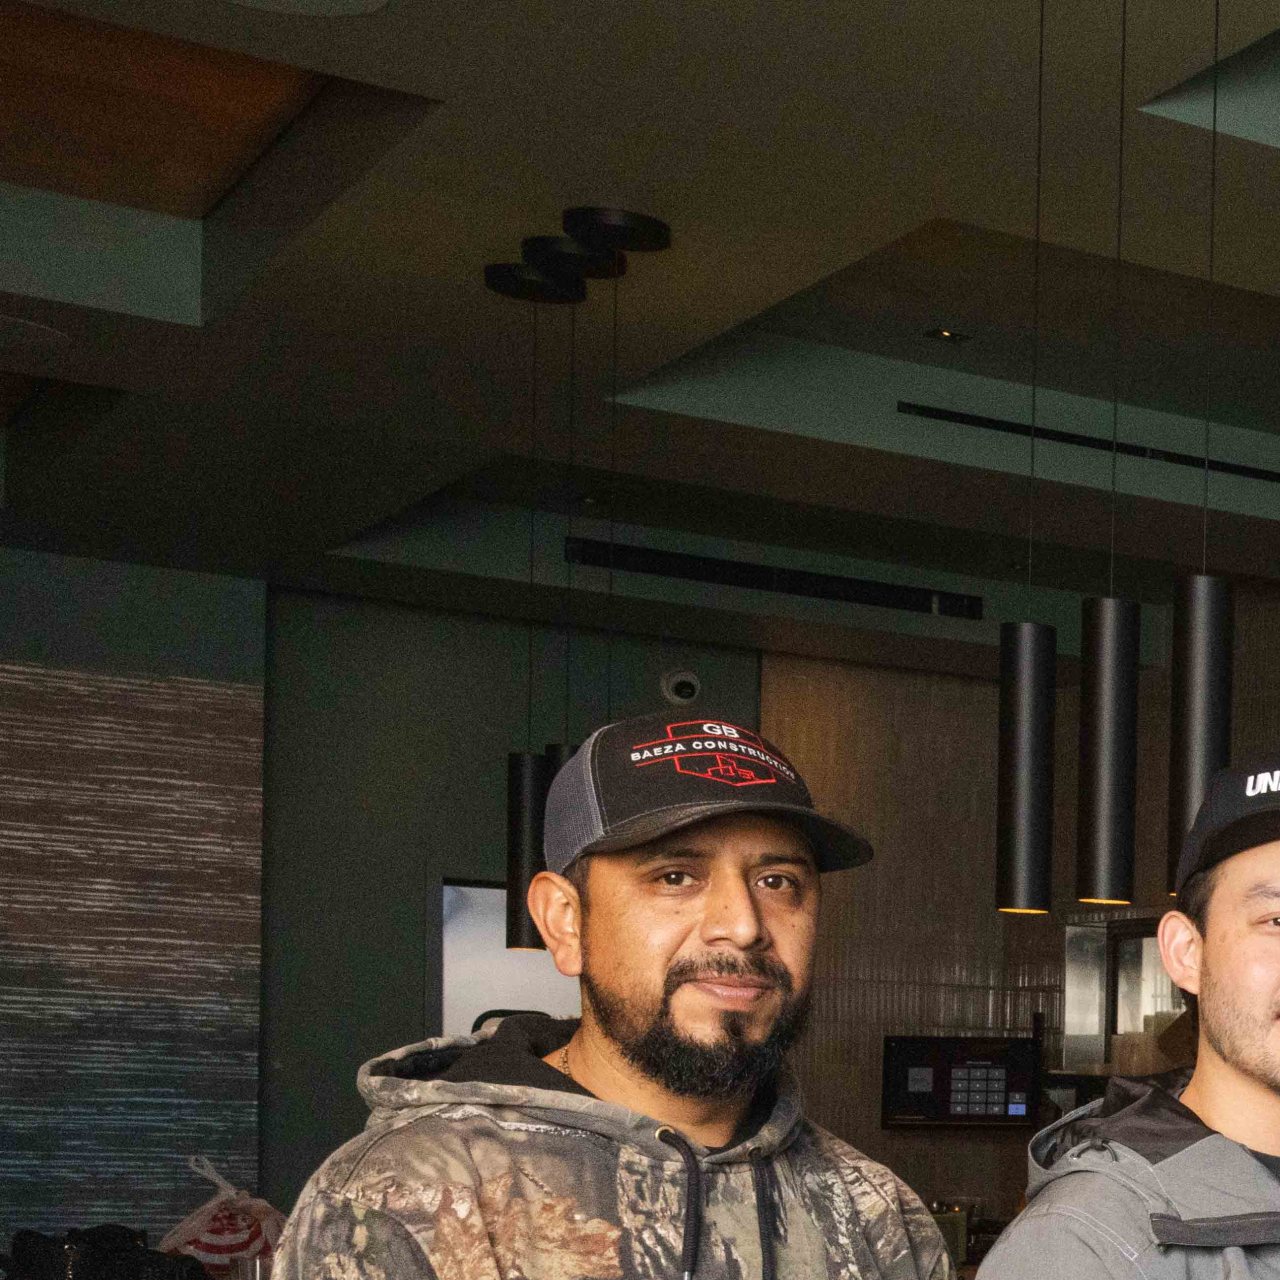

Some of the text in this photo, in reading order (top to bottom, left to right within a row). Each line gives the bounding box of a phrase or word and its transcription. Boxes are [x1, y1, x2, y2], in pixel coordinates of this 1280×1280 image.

[702, 723, 740, 739] GB
[630, 740, 795, 780] BAEZA CONSTRUCTION
